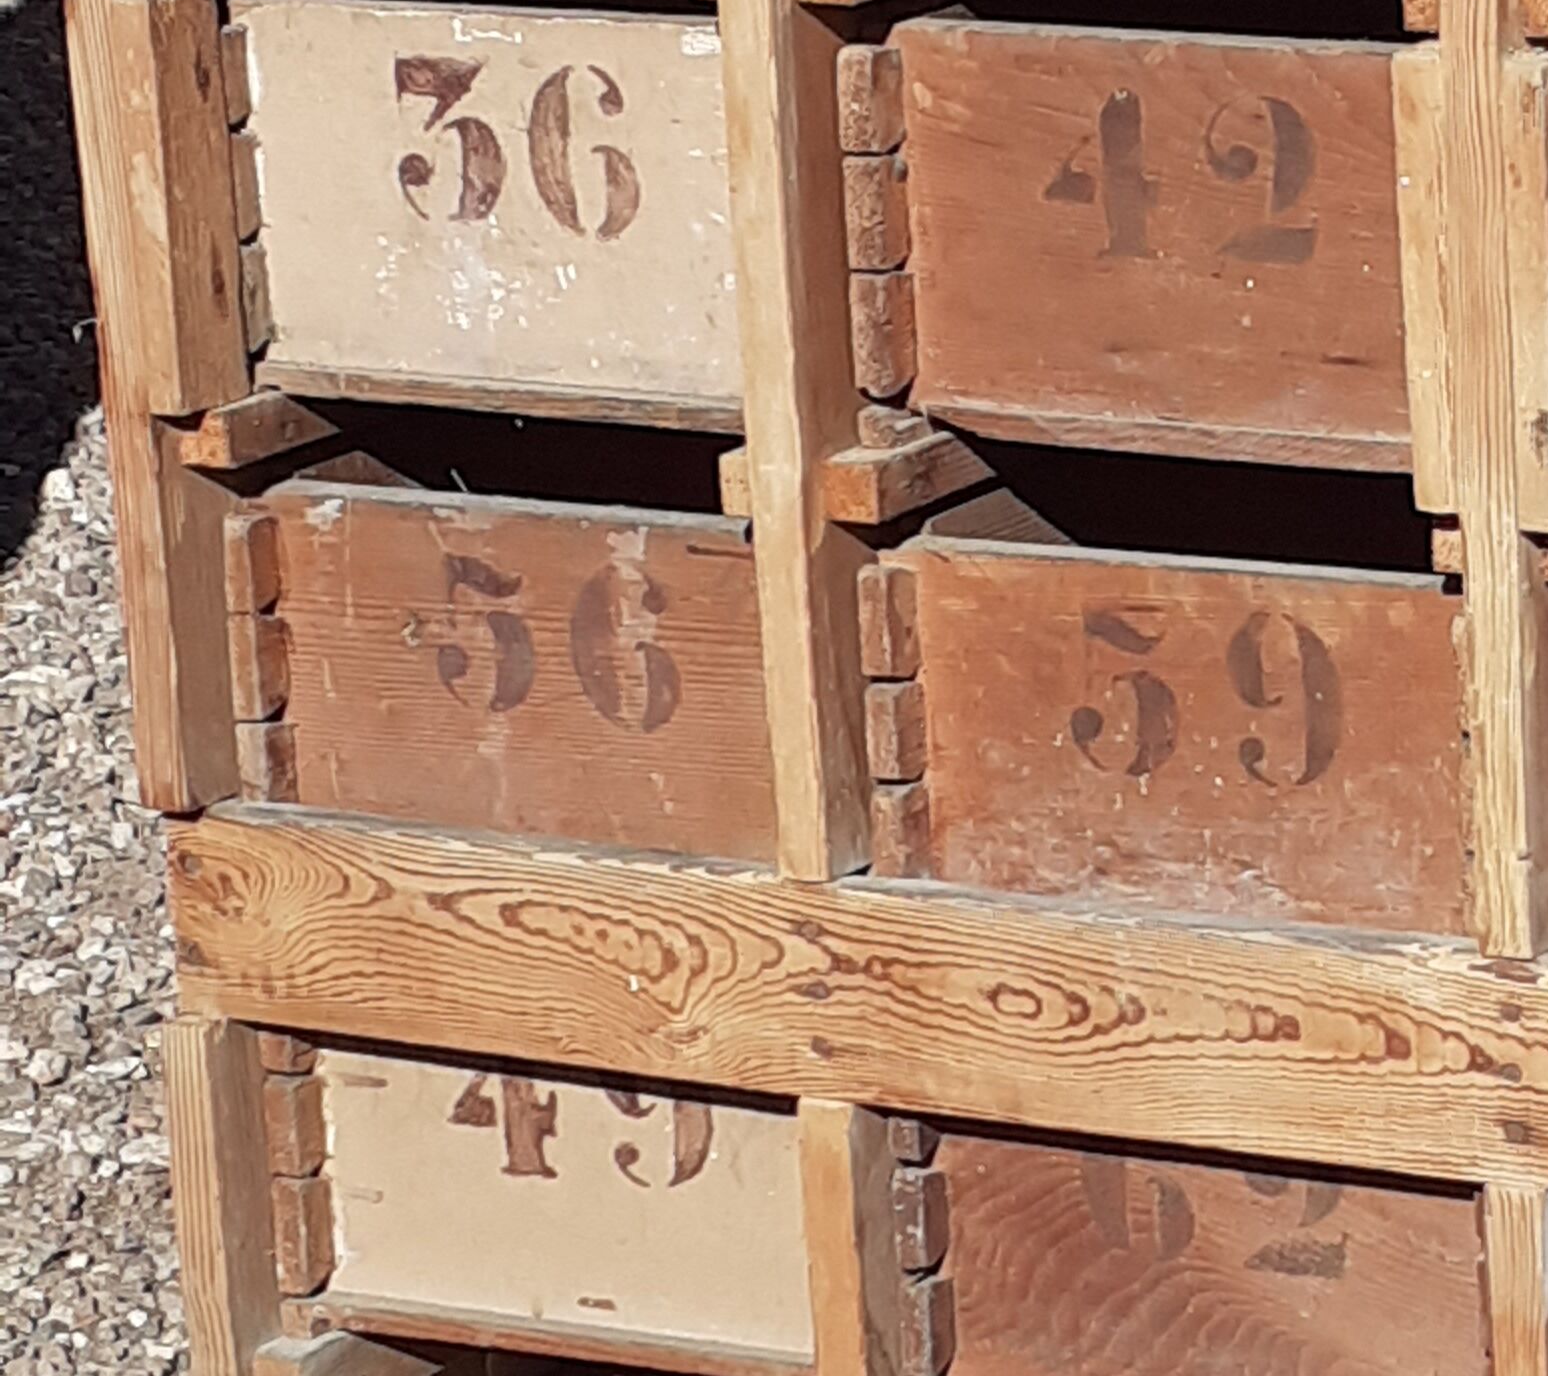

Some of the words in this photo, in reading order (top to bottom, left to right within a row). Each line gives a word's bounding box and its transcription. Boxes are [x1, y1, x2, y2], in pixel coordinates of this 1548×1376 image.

[394, 53, 641, 242] 36
[1041, 88, 1320, 265] 42
[437, 552, 682, 734] 56
[1071, 605, 1343, 787] 59
